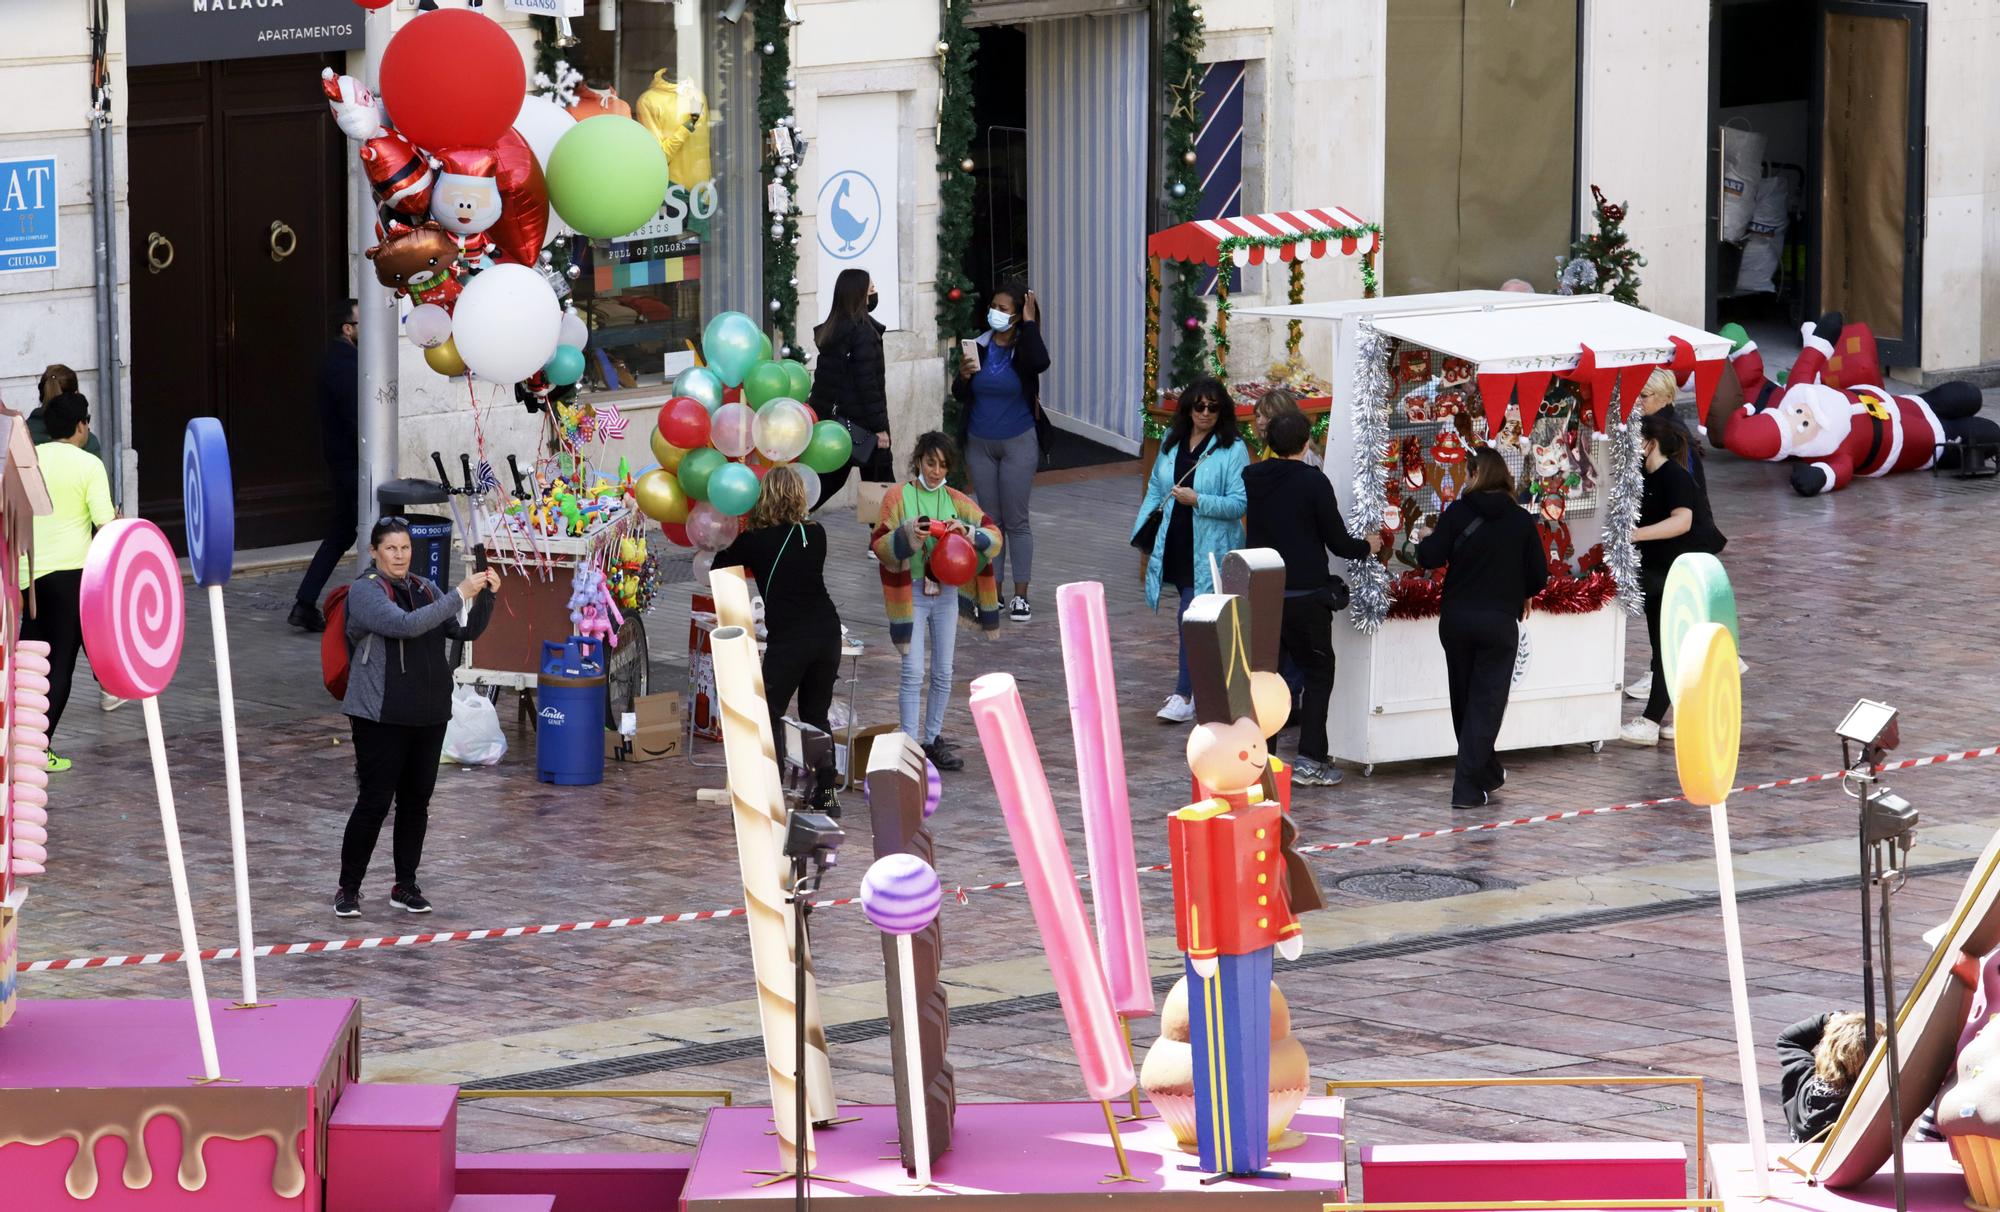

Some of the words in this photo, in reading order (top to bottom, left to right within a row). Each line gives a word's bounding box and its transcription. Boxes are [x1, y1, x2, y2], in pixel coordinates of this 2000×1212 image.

[526, 0, 556, 10] GANSO
[257, 24, 353, 42] APARTAMENTOS
[2, 167, 50, 211] AT
[608, 249, 631, 260] FULL
[636, 246, 648, 256] OF
[653, 242, 687, 254] COLORS
[8, 255, 47, 267] CIUDAD
[411, 527, 427, 535] 900
[538, 706, 565, 719] Linde
